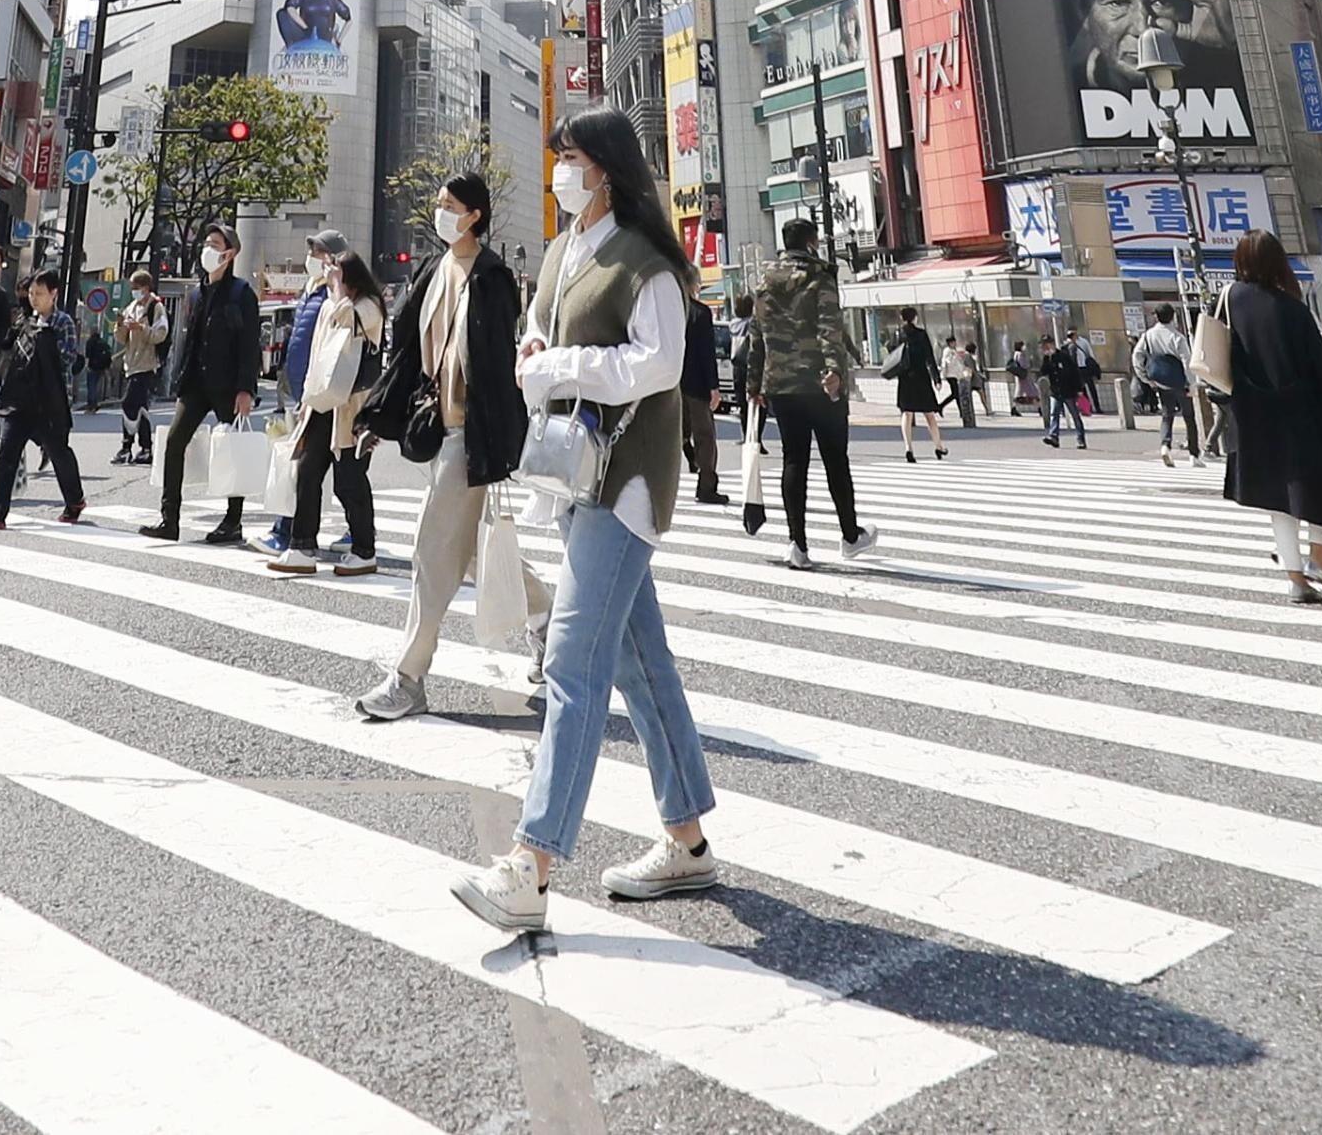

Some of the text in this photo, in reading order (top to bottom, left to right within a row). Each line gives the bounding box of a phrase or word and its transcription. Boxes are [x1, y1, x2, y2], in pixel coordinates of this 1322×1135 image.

[1079, 87, 1254, 139] DMM
[1019, 186, 1251, 239] 大堂書店
